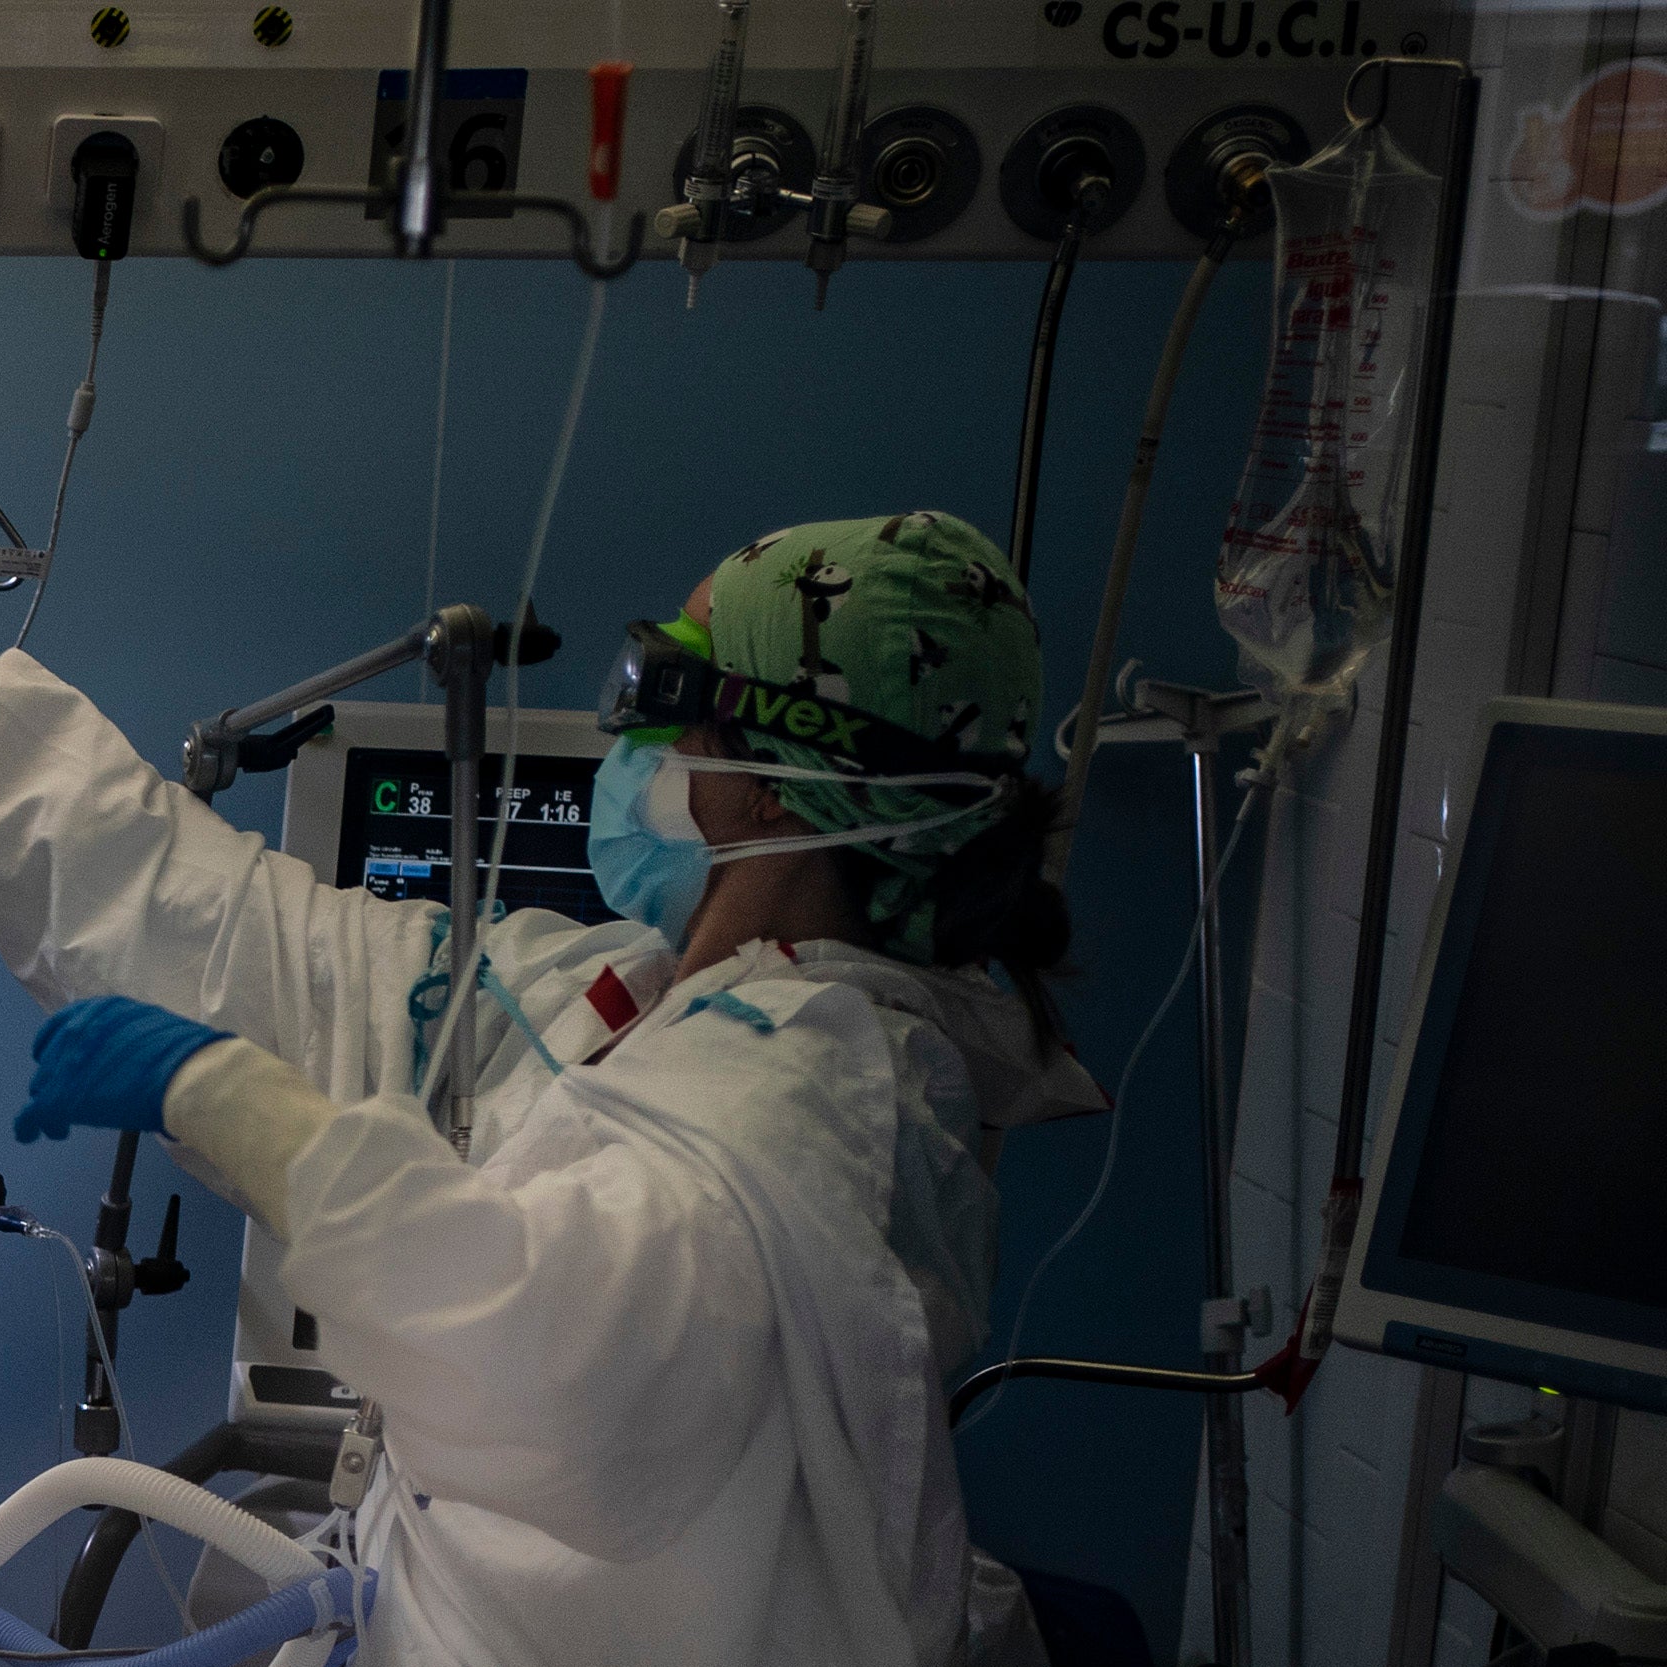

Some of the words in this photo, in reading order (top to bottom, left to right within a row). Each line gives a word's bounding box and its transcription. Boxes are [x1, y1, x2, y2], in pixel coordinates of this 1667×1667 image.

[1103, 1, 1376, 58] CS-U.C.I.
[97, 181, 118, 245] Aerogen
[375, 781, 397, 812] C
[408, 796, 431, 815] 38
[495, 787, 531, 800] PEEP
[555, 790, 573, 802] I:E
